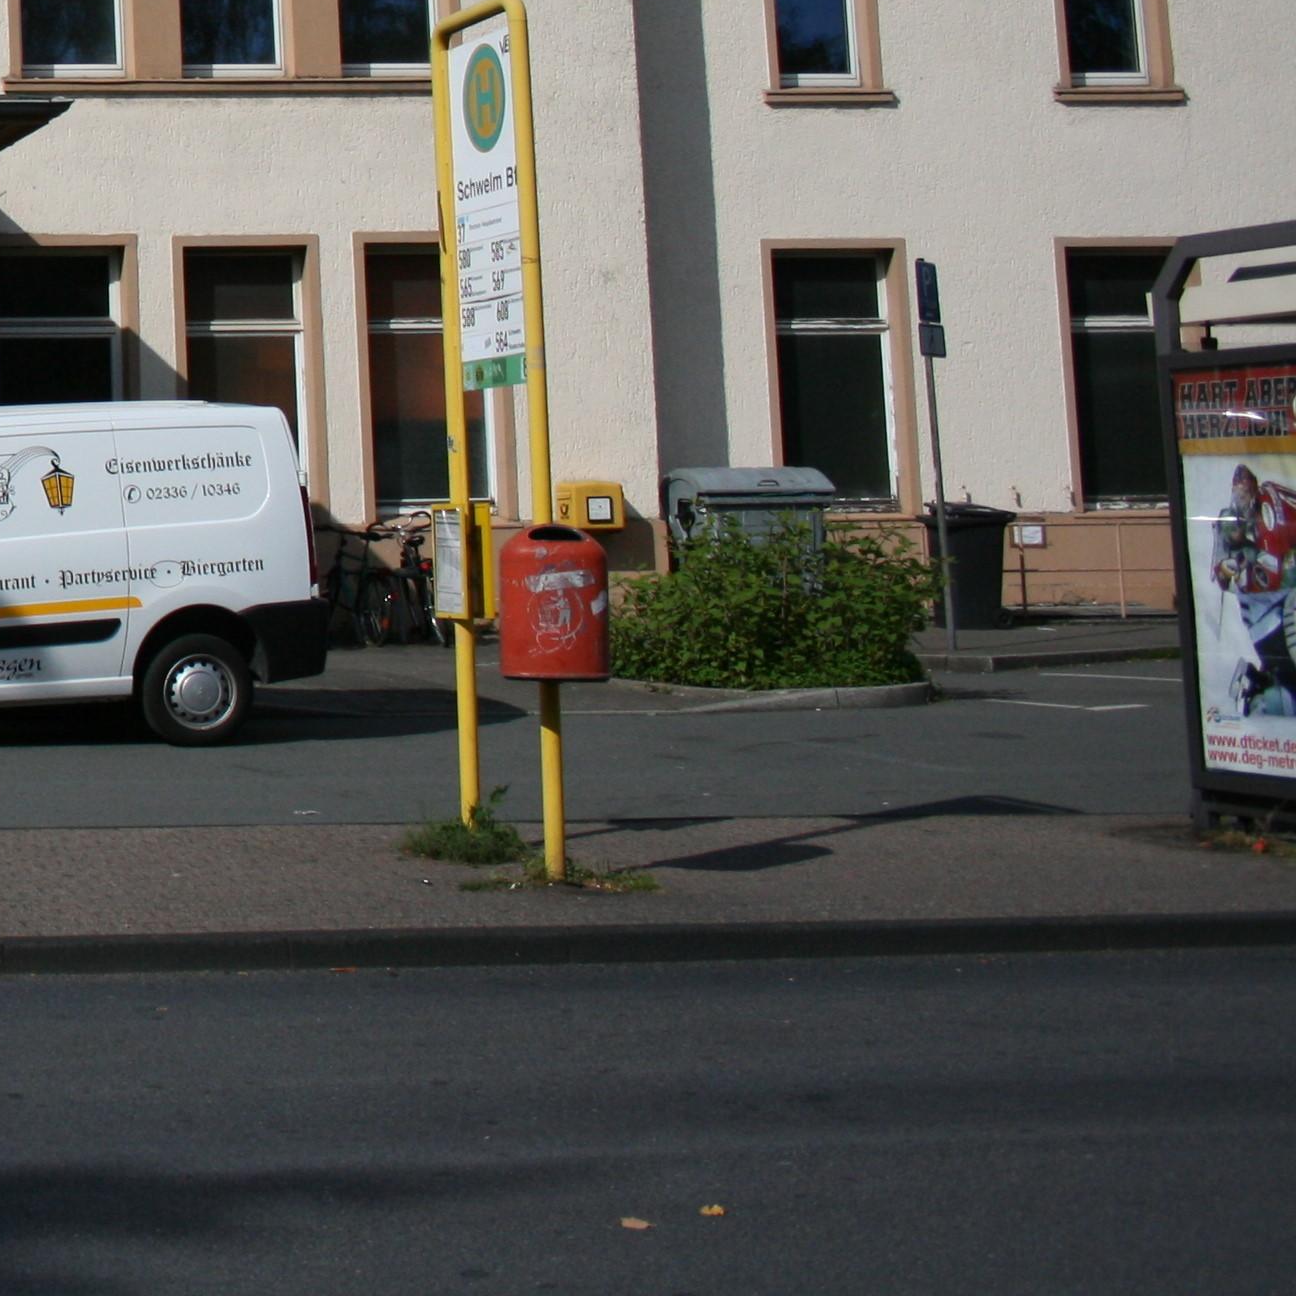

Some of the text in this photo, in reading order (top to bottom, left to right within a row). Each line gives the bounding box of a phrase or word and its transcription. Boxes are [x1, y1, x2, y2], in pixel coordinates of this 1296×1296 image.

[457, 171, 503, 202] Schwelm
[1179, 380, 1238, 410] HART
[105, 452, 252, 475] Eisenwerkschänke
[146, 486, 188, 500] 02336
[202, 482, 241, 497] 10346
[59, 564, 158, 589] Partyservice
[180, 557, 265, 578] Biergarten
